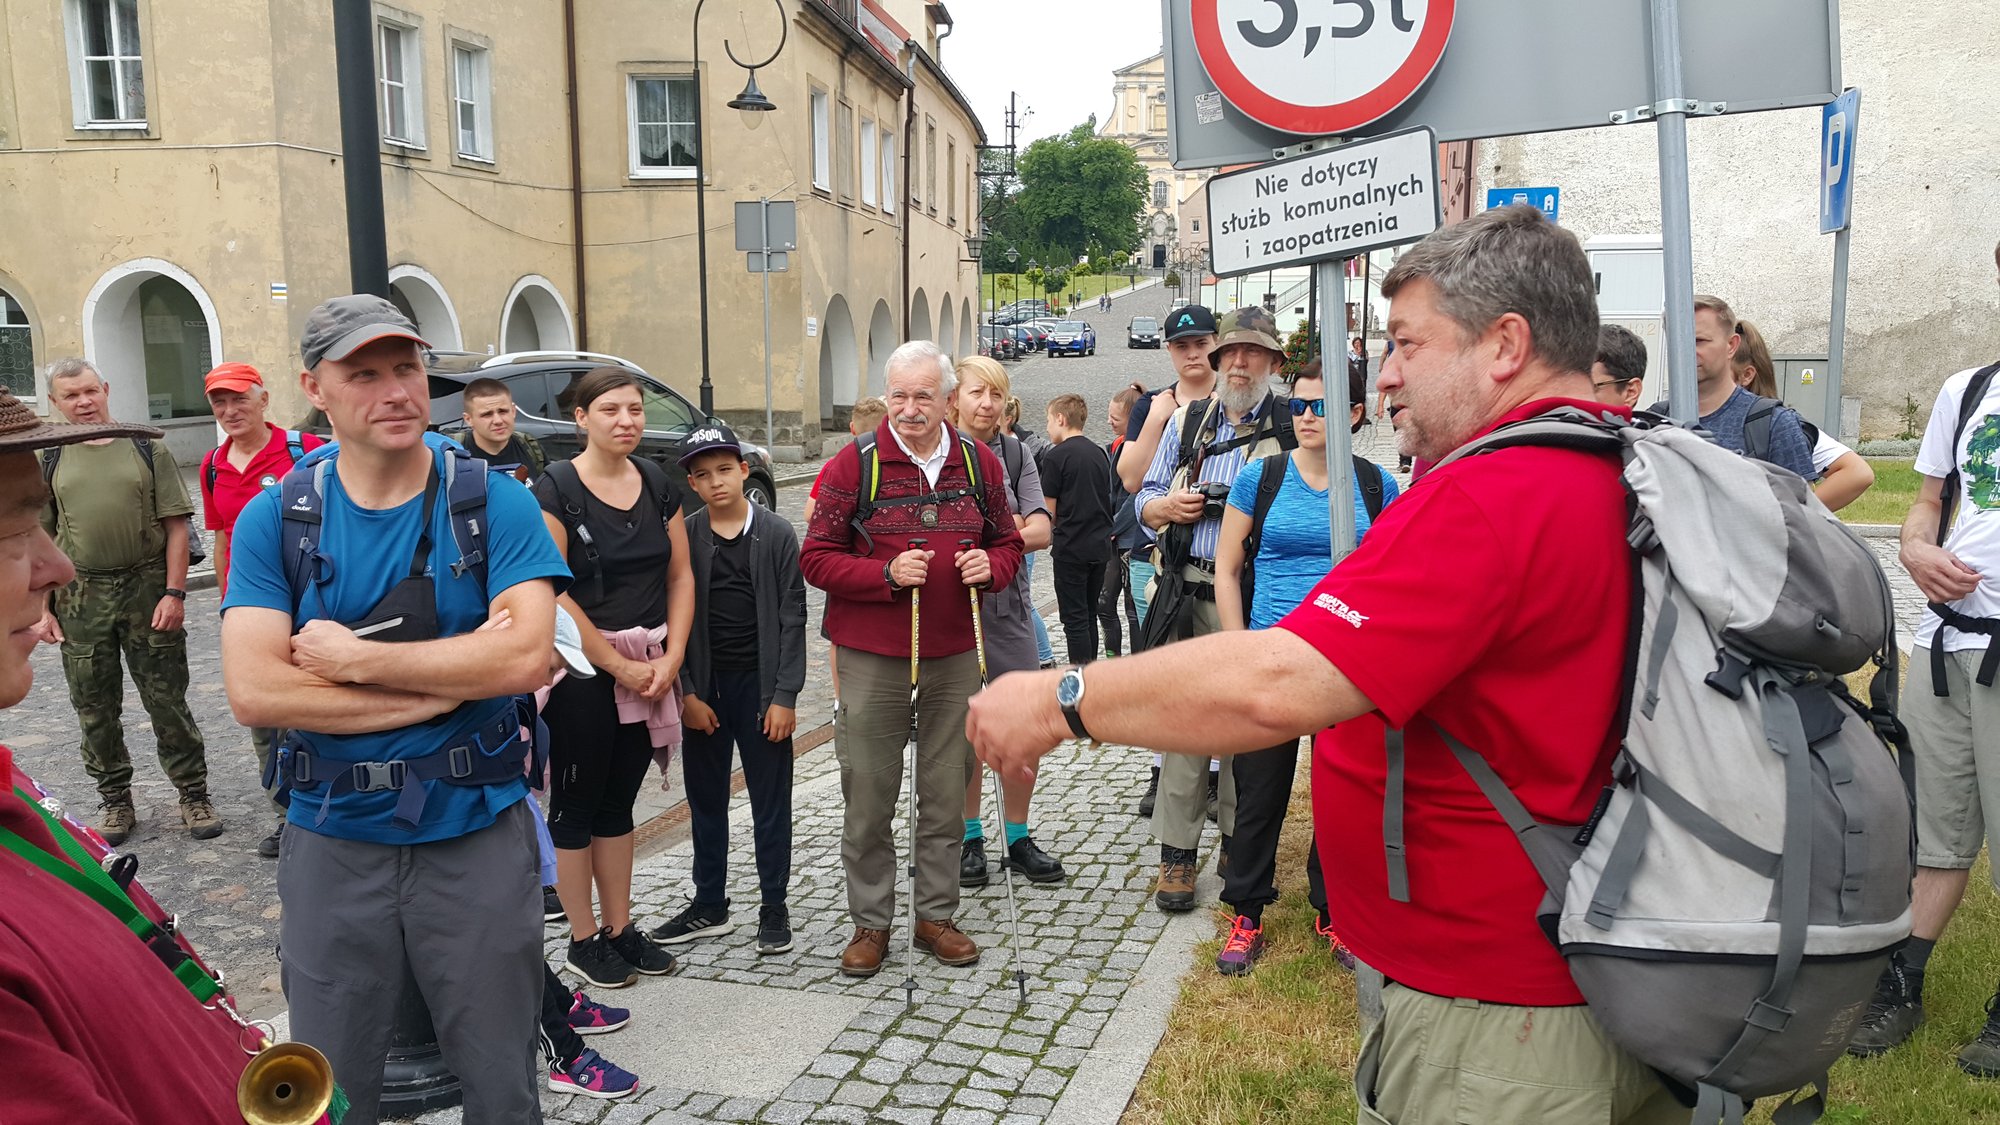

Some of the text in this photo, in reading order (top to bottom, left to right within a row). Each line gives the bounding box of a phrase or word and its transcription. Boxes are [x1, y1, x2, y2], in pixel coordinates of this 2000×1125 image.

[1255, 156, 1378, 198] Nie dotyczy
[1221, 173, 1423, 235] służb komunalnych
[1244, 211, 1398, 259] i zaopatrzenia
